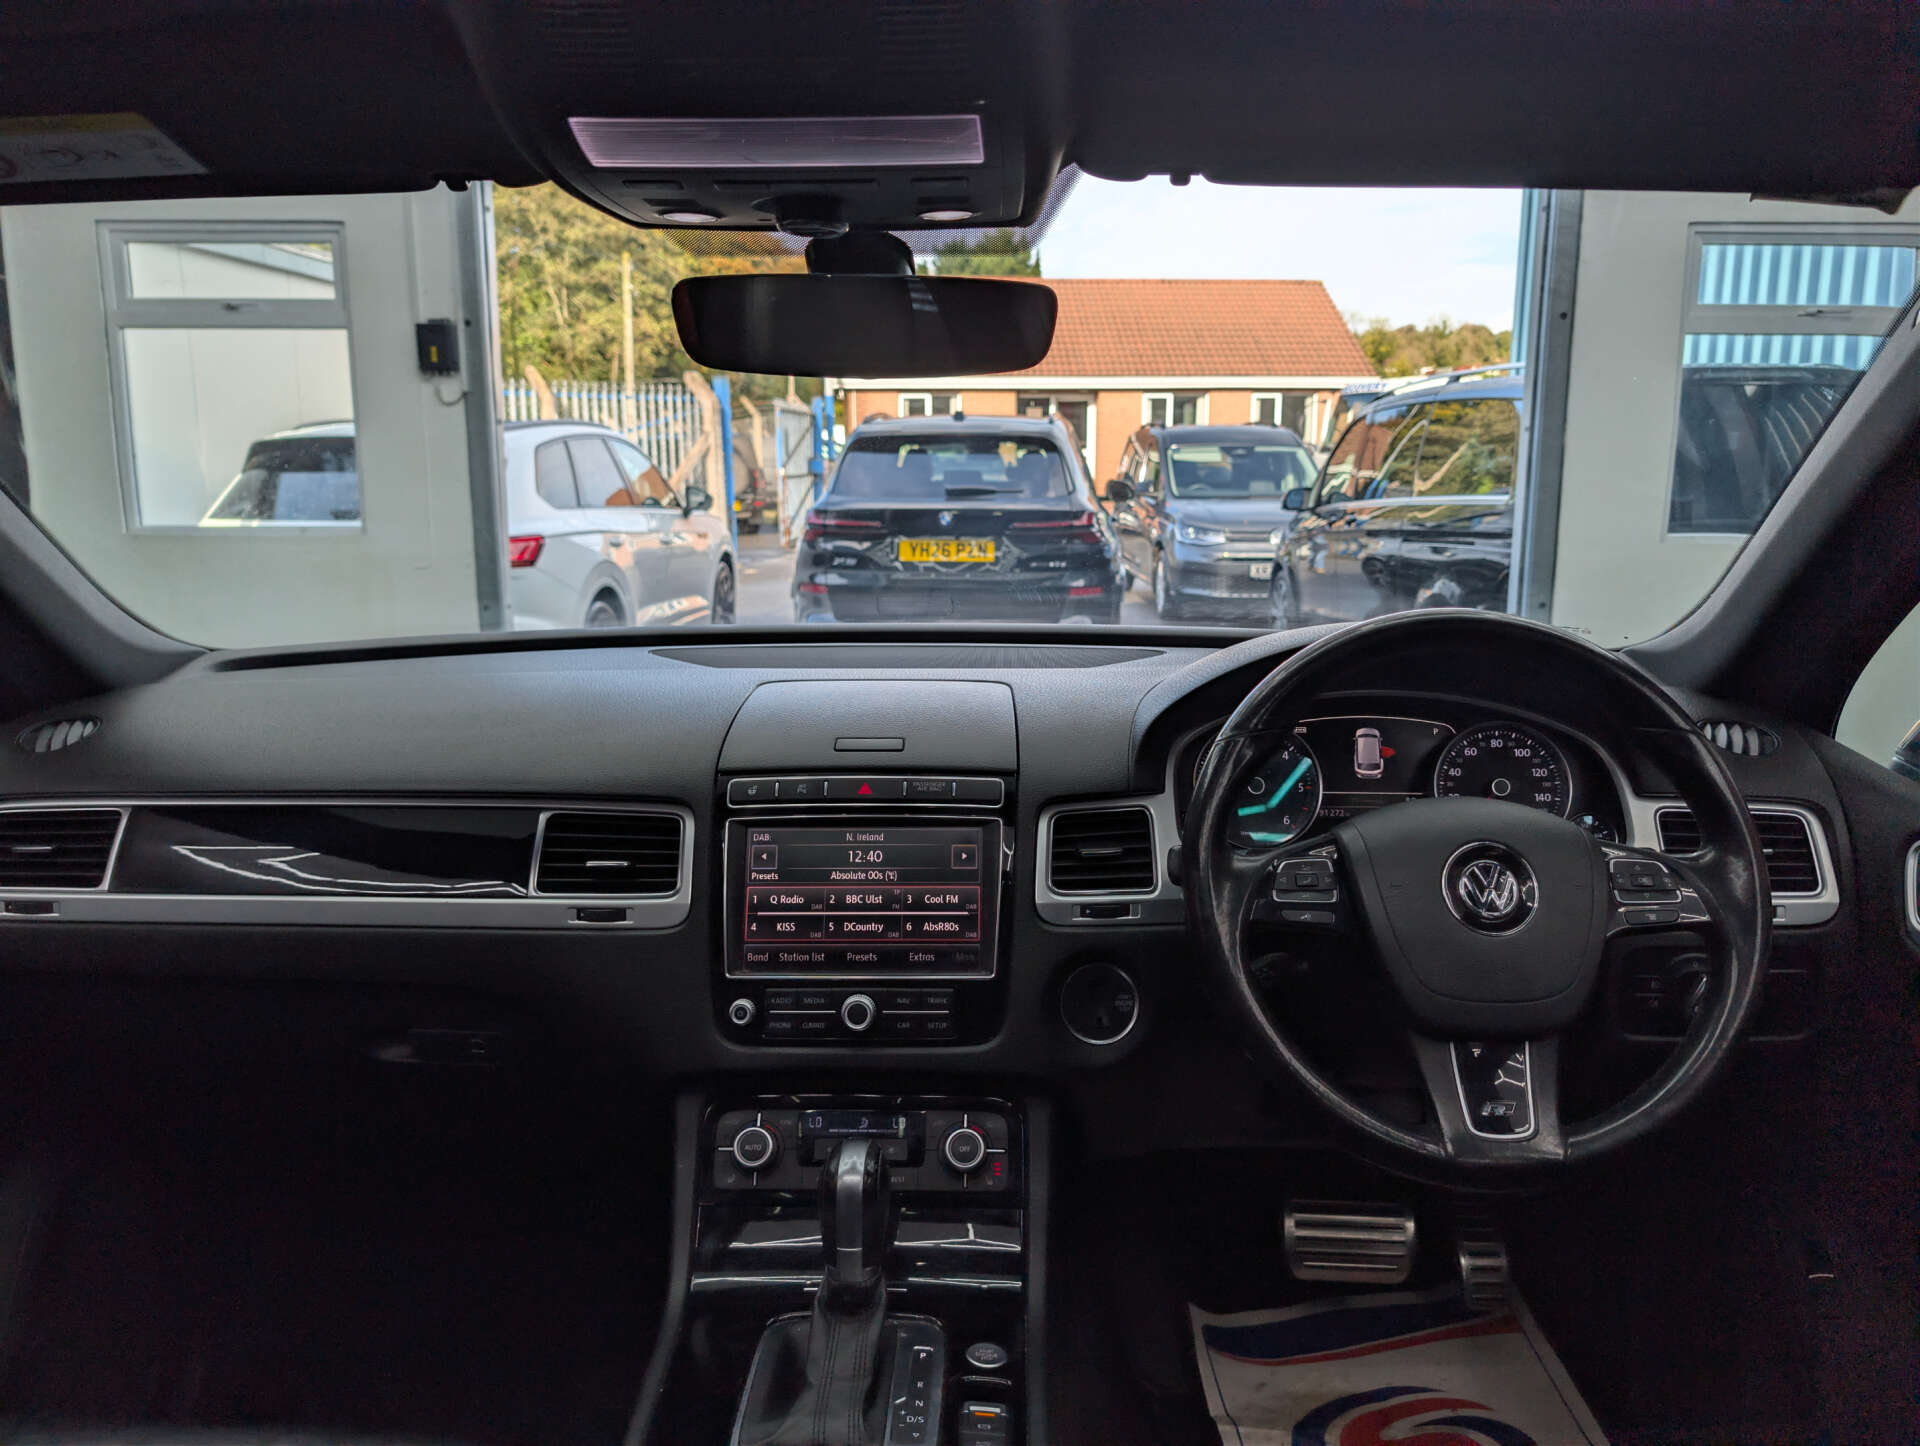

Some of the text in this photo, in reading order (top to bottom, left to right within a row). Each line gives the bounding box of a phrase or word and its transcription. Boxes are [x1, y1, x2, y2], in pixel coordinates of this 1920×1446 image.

[1490, 739, 1503, 748] 80
[1282, 751, 1289, 760] 4
[1464, 747, 1478, 757] 60
[1513, 748, 1531, 758] 100
[1448, 768, 1462, 777] 40
[1531, 768, 1548, 777] 120
[1298, 783, 1304, 793] 5
[1534, 793, 1552, 802] 140
[1283, 816, 1290, 825] 6
[856, 832, 884, 841] Ireland
[848, 850, 883, 863] 12:40
[751, 872, 779, 881] Presets
[830, 871, 866, 880] Absolute
[752, 895, 804, 905] 1 Q Radio
[829, 895, 883, 904] 2 BBC Ulst
[907, 895, 959, 904] 3 Cool FM
[750, 923, 796, 931] 4 KISS
[828, 923, 884, 933] 5 DCountry
[906, 923, 960, 931] 6 AbsR80s
[747, 953, 769, 962] Band
[779, 952, 825, 962] Station list
[847, 952, 878, 962] Presets
[909, 952, 935, 962] Extras
[744, 1143, 762, 1152] AUTO
[906, 1415, 925, 1424] D/S
